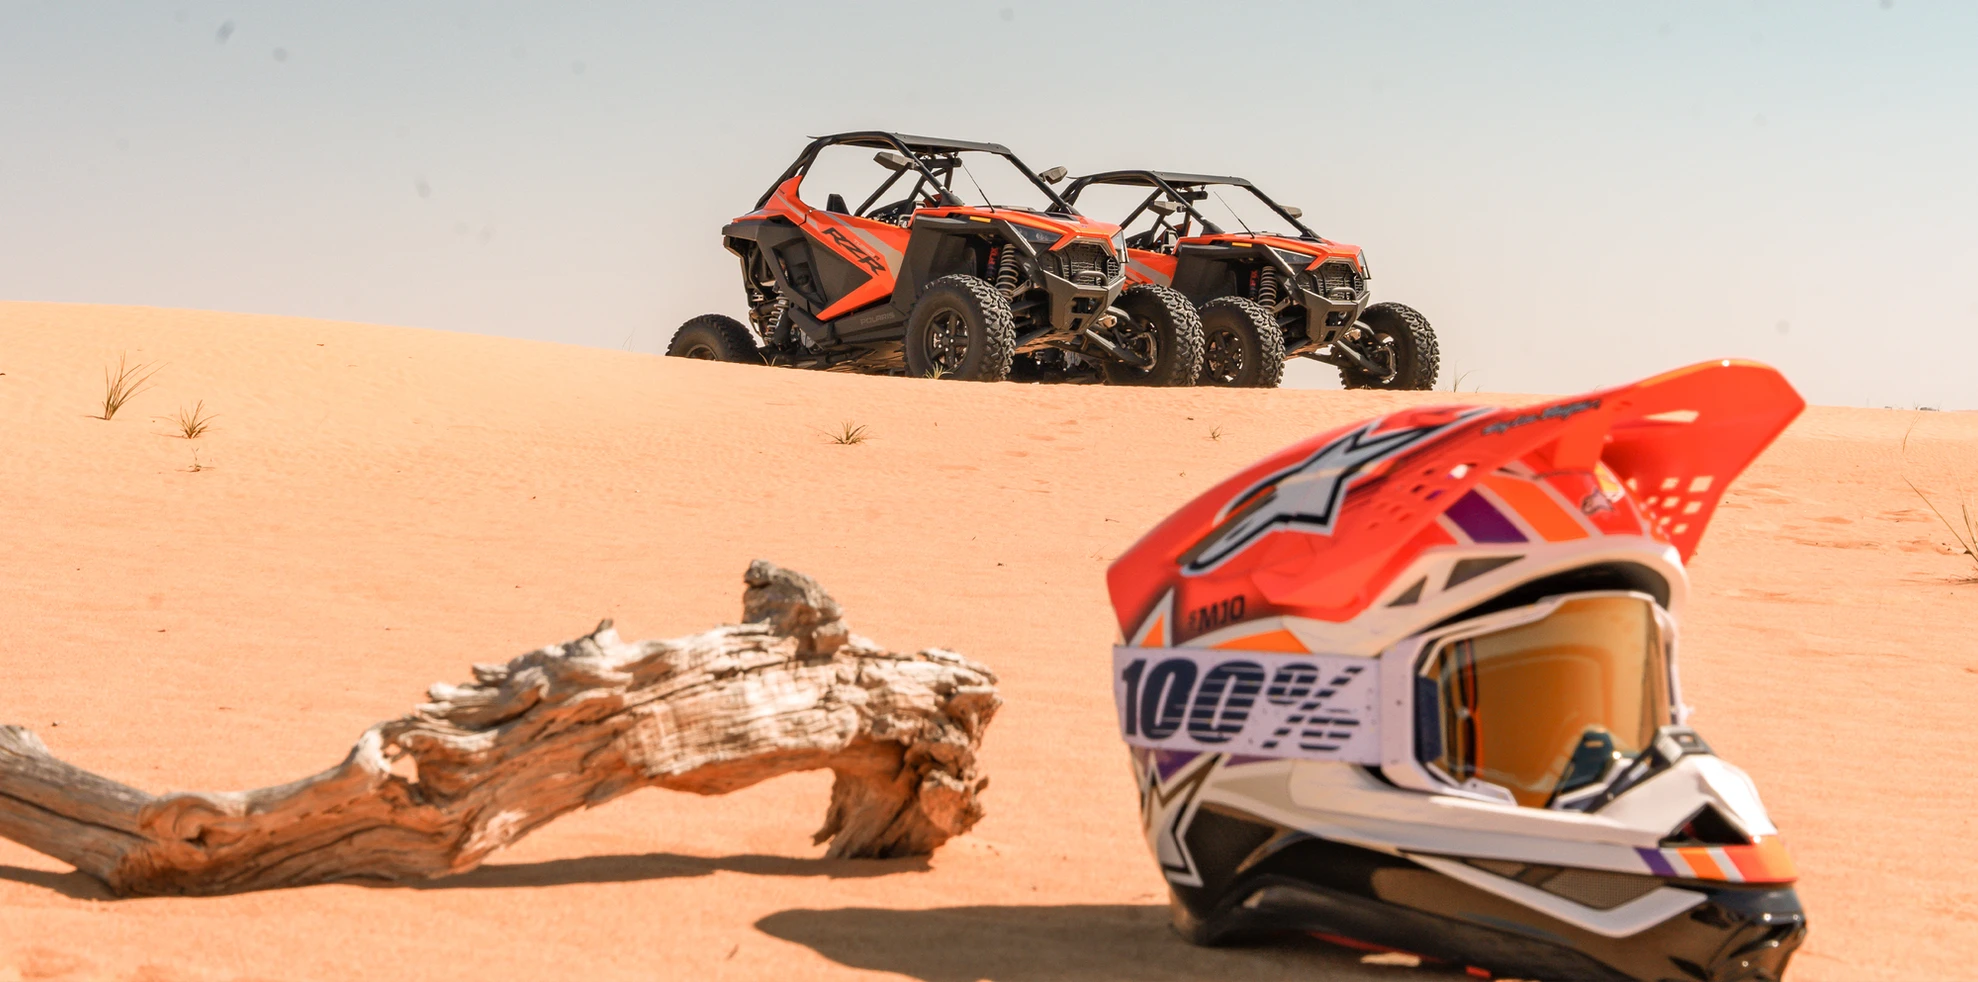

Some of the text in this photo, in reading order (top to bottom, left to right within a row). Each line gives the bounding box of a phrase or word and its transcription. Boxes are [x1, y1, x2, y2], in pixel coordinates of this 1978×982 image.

[822, 227, 886, 275] RZR
[860, 311, 895, 325] POLARIS
[1122, 658, 1364, 751] 100%
